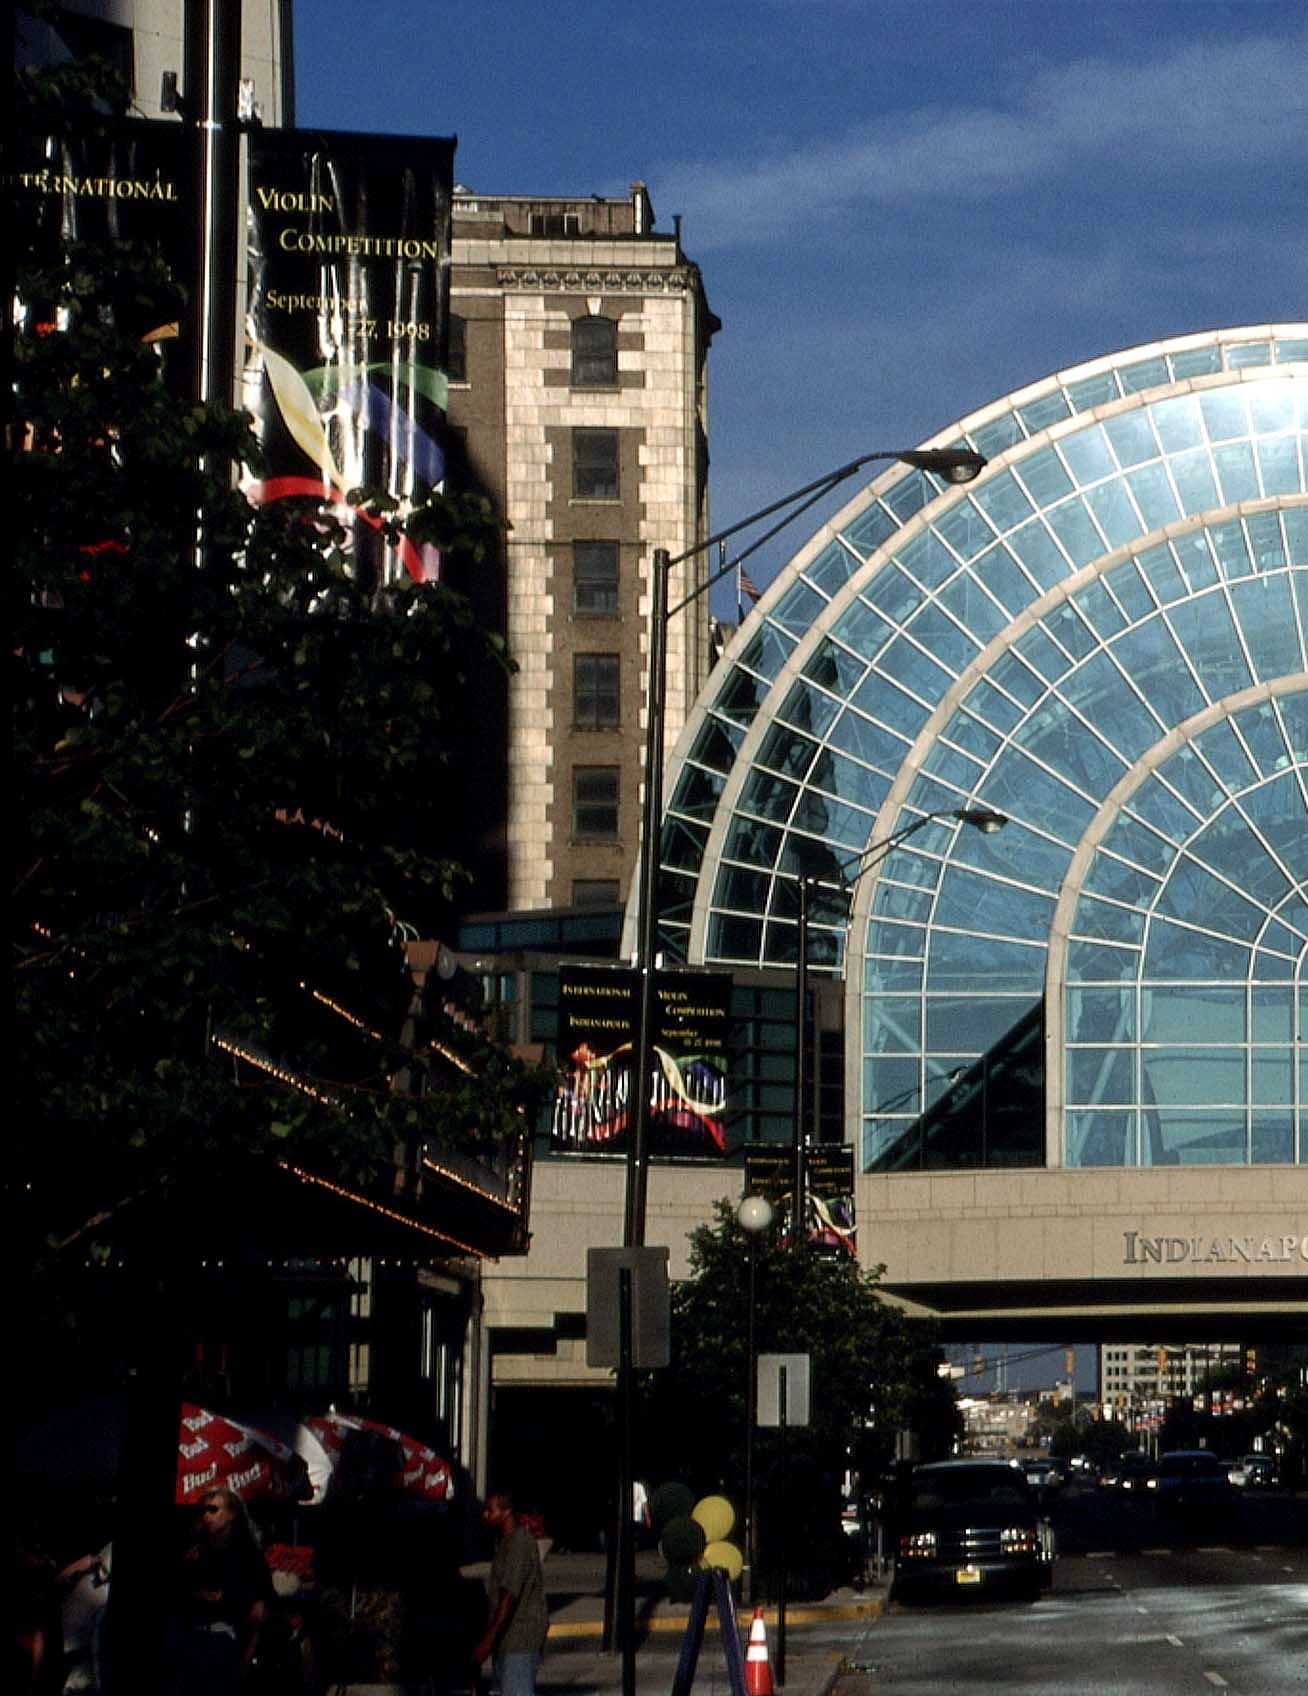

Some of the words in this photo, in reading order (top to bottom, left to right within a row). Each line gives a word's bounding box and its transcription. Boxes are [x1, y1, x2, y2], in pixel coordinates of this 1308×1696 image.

[1, 171, 178, 201] TERNATIONAL
[255, 187, 334, 213] VIOLIN
[279, 228, 438, 260] COMPETITION
[386, 320, 431, 341] 1998
[182, 1461, 218, 1495] Bud
[226, 1461, 262, 1493] Bud
